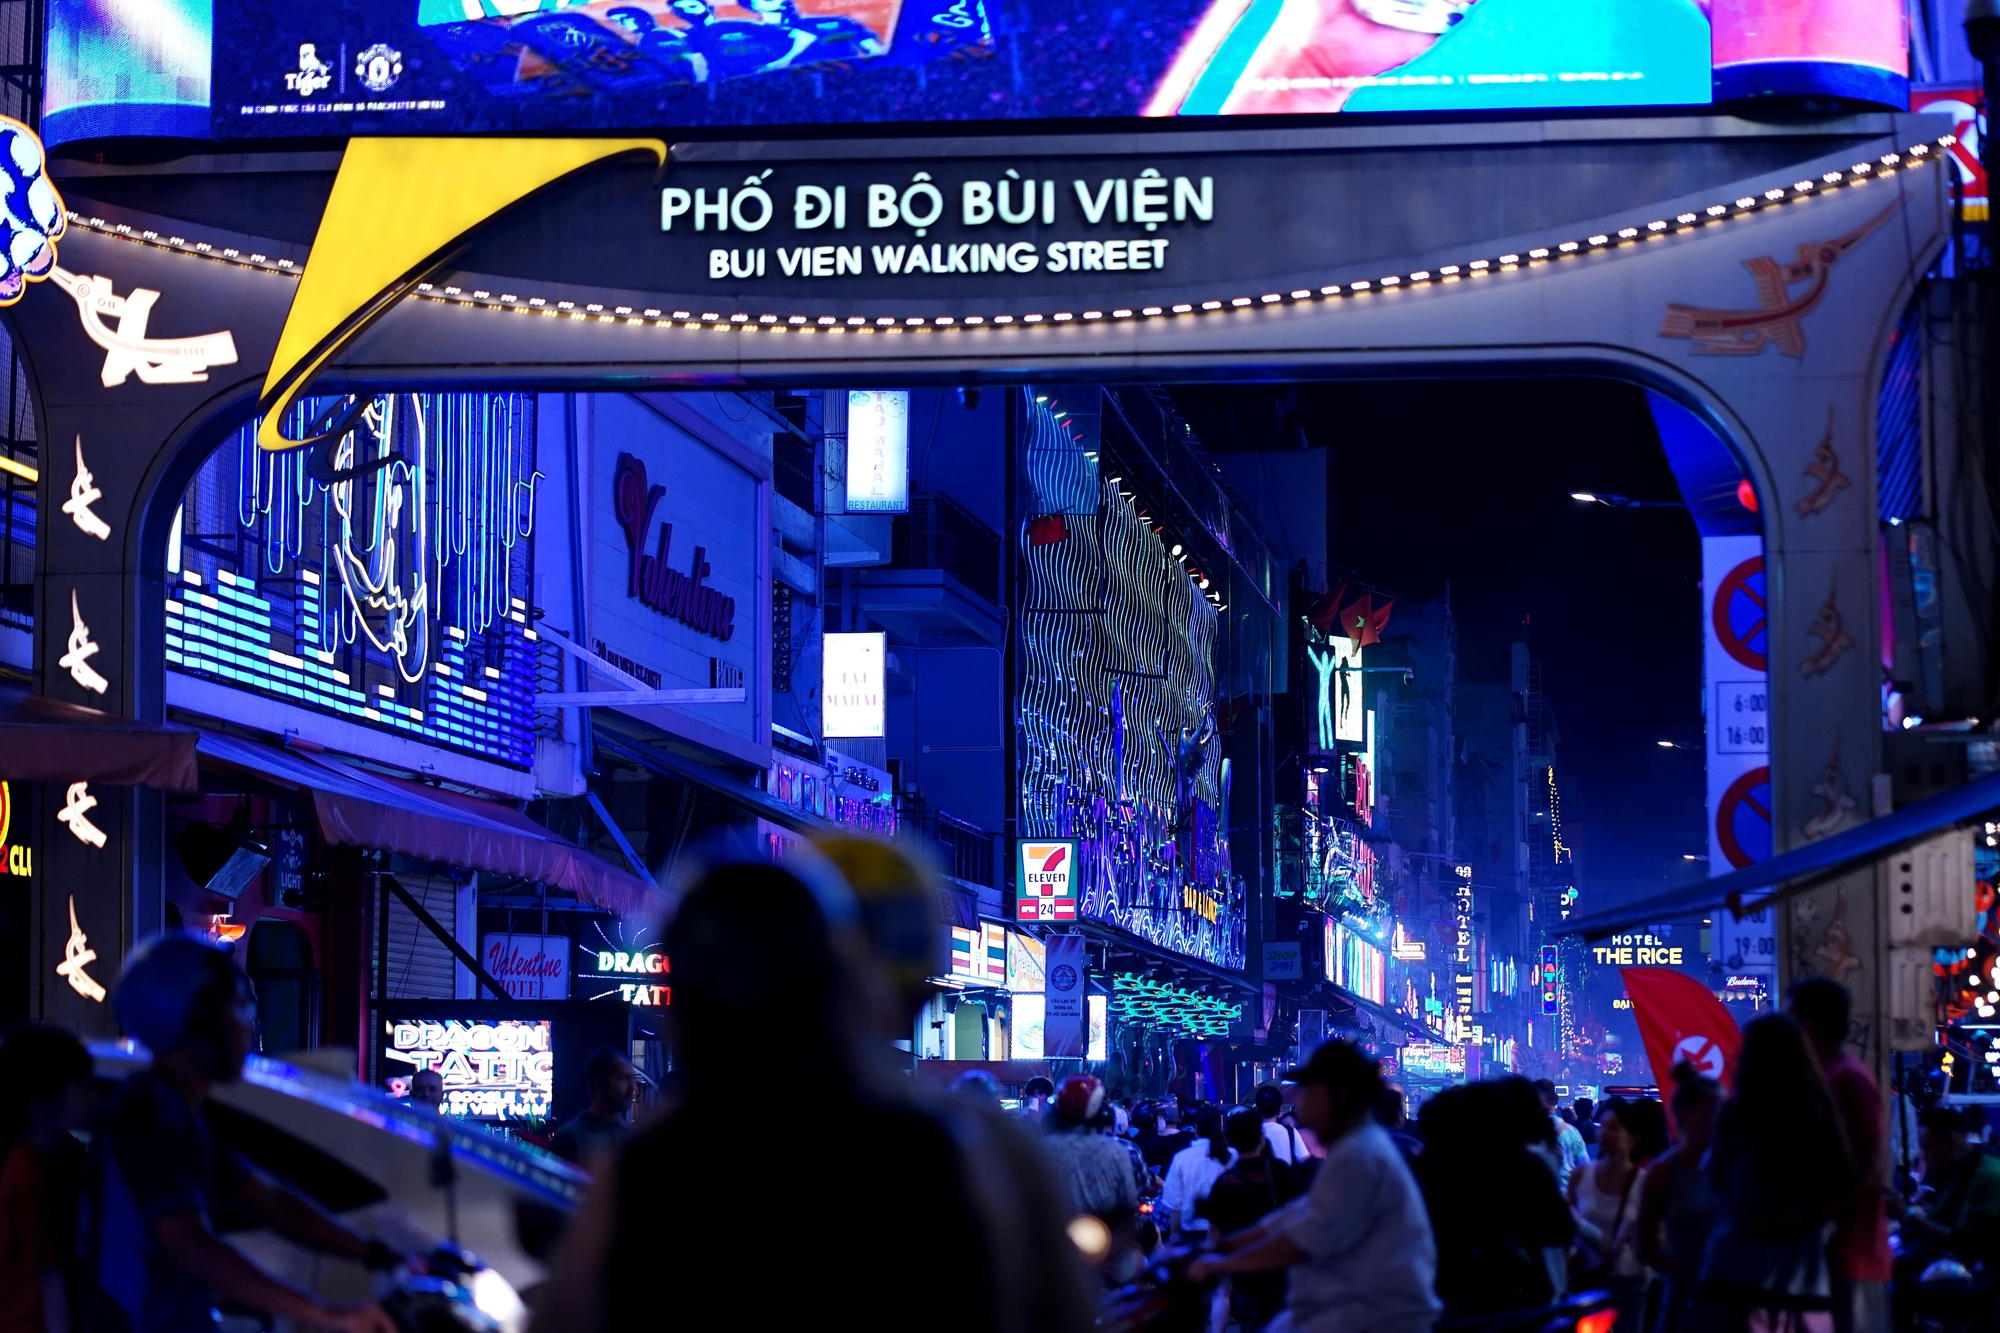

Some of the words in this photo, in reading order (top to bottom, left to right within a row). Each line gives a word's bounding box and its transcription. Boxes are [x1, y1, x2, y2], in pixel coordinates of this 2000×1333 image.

[284, 71, 331, 96] Tiger
[661, 168, 773, 232] PHỐ
[793, 185, 846, 229] ĐI
[868, 171, 943, 237] BỘ
[962, 168, 1054, 225] BÙI
[1073, 168, 1214, 231] VIỆN
[709, 248, 765, 279] BUI
[776, 246, 862, 277] VIEN
[871, 241, 1039, 274] WALKING
[1045, 239, 1169, 271] STREET
[848, 501, 904, 510] RESTAURANT
[1727, 726, 1765, 744] 16:00
[1040, 904, 1053, 915] 24
[1612, 935, 1662, 946] HOTEL
[489, 941, 562, 978] Valentine
[599, 951, 671, 973] DRAG
[1266, 950, 1298, 960] SHOP
[1593, 948, 1633, 964] THE
[1637, 948, 1683, 964] RICE
[1269, 961, 1294, 972] 24H
[394, 1024, 546, 1050] DRAGON
[449, 1091, 516, 1103] GOOGLE
